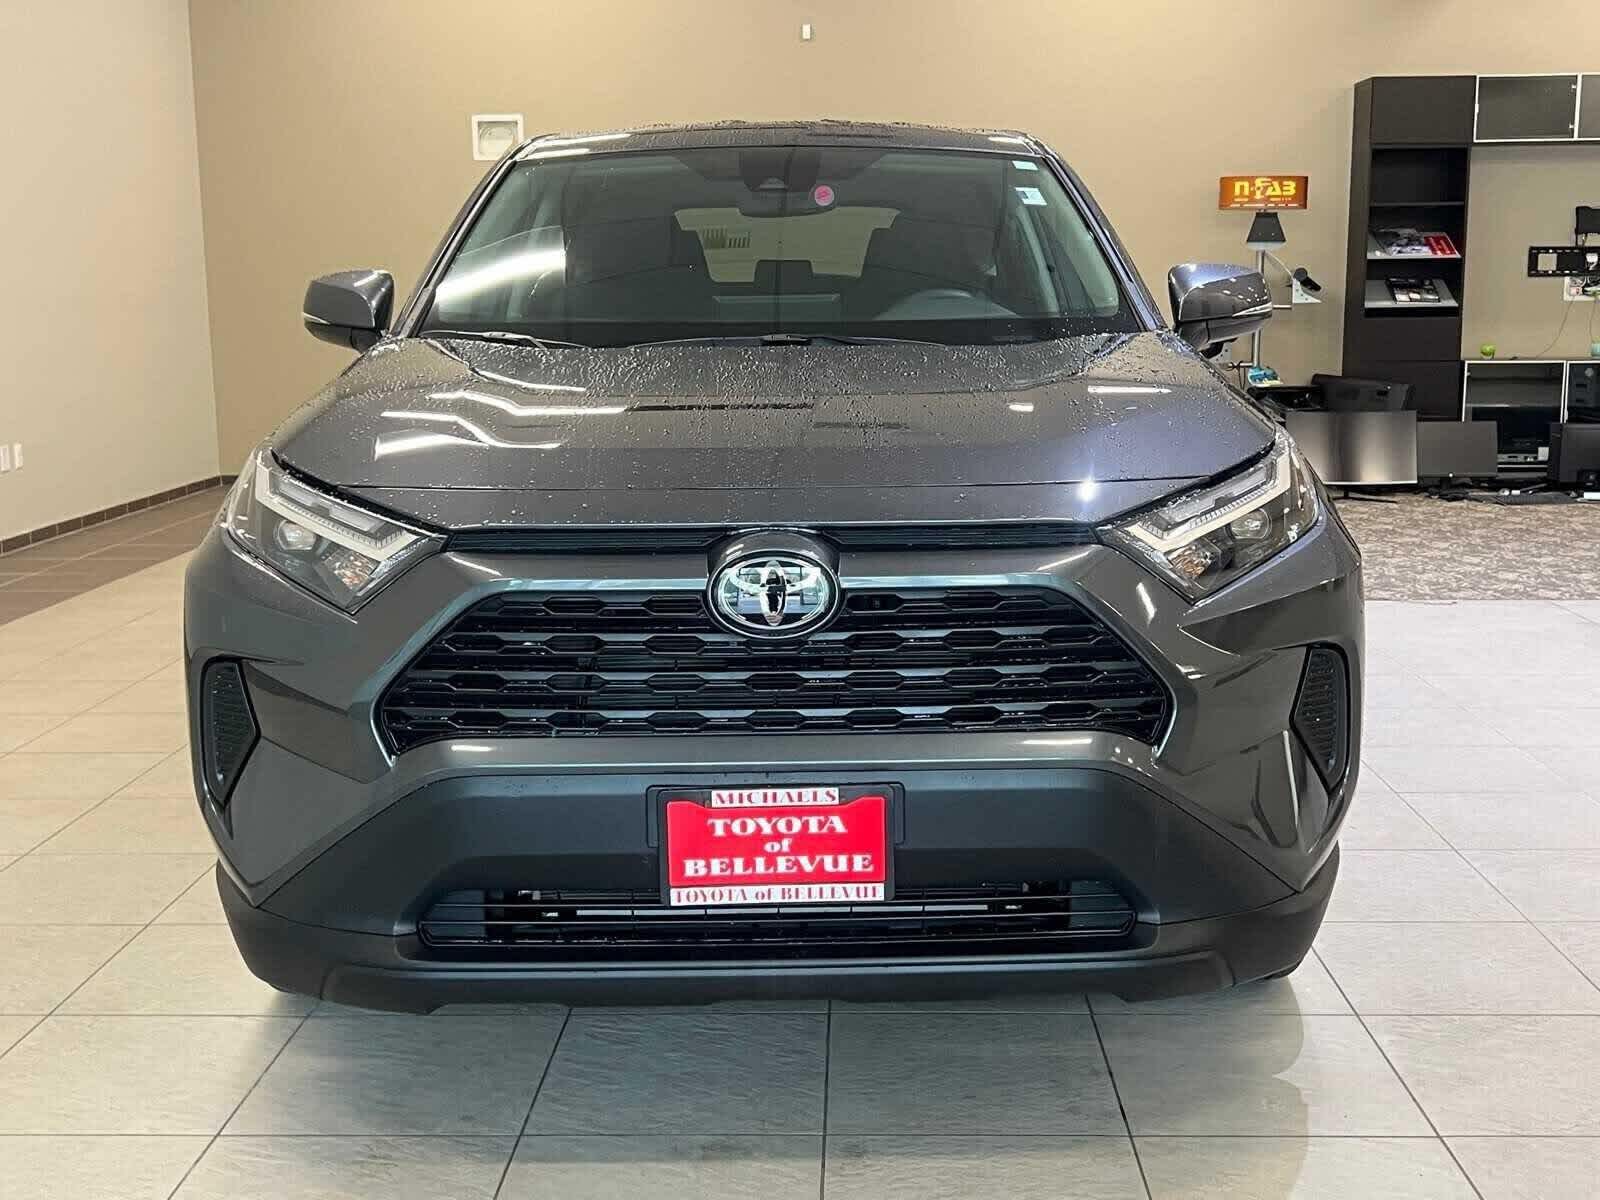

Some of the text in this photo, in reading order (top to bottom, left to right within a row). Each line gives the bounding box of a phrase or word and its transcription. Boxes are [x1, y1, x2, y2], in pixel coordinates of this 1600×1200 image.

[716, 789, 837, 805] MICHAELS
[707, 815, 848, 837] TOYOTA
[764, 838, 792, 853] of
[683, 855, 874, 877] BELLEVUE
[675, 885, 882, 904] TOYOTA of BELLEVUE
